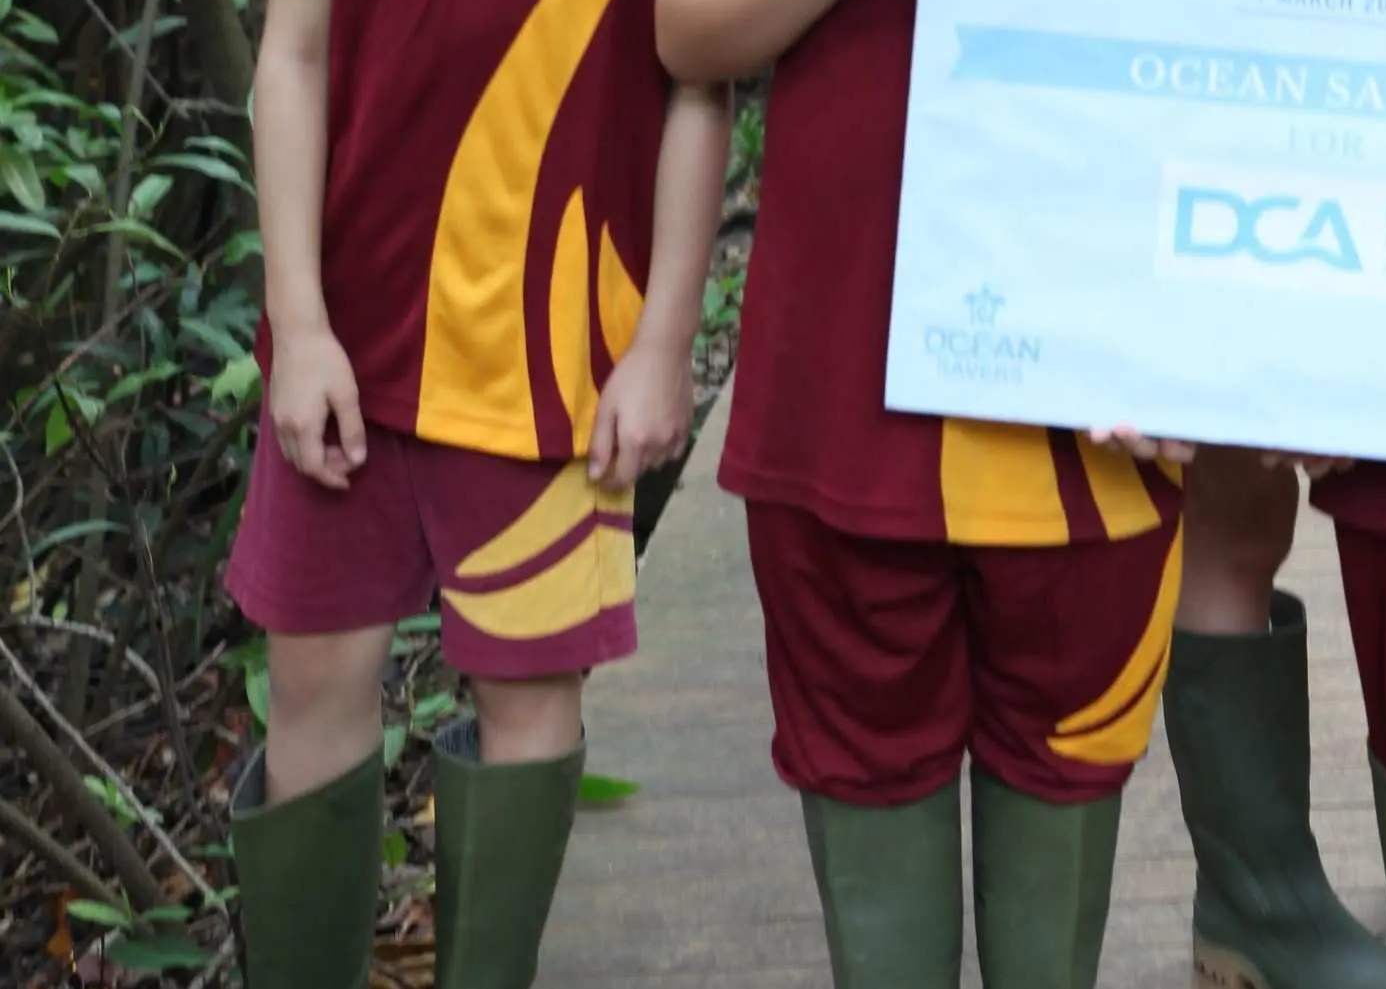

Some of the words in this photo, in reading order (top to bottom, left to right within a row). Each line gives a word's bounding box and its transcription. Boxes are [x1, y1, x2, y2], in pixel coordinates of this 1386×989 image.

[1130, 52, 1308, 107] OCEAN
[1174, 185, 1364, 274] DCA
[925, 325, 1042, 364] OCEAN
